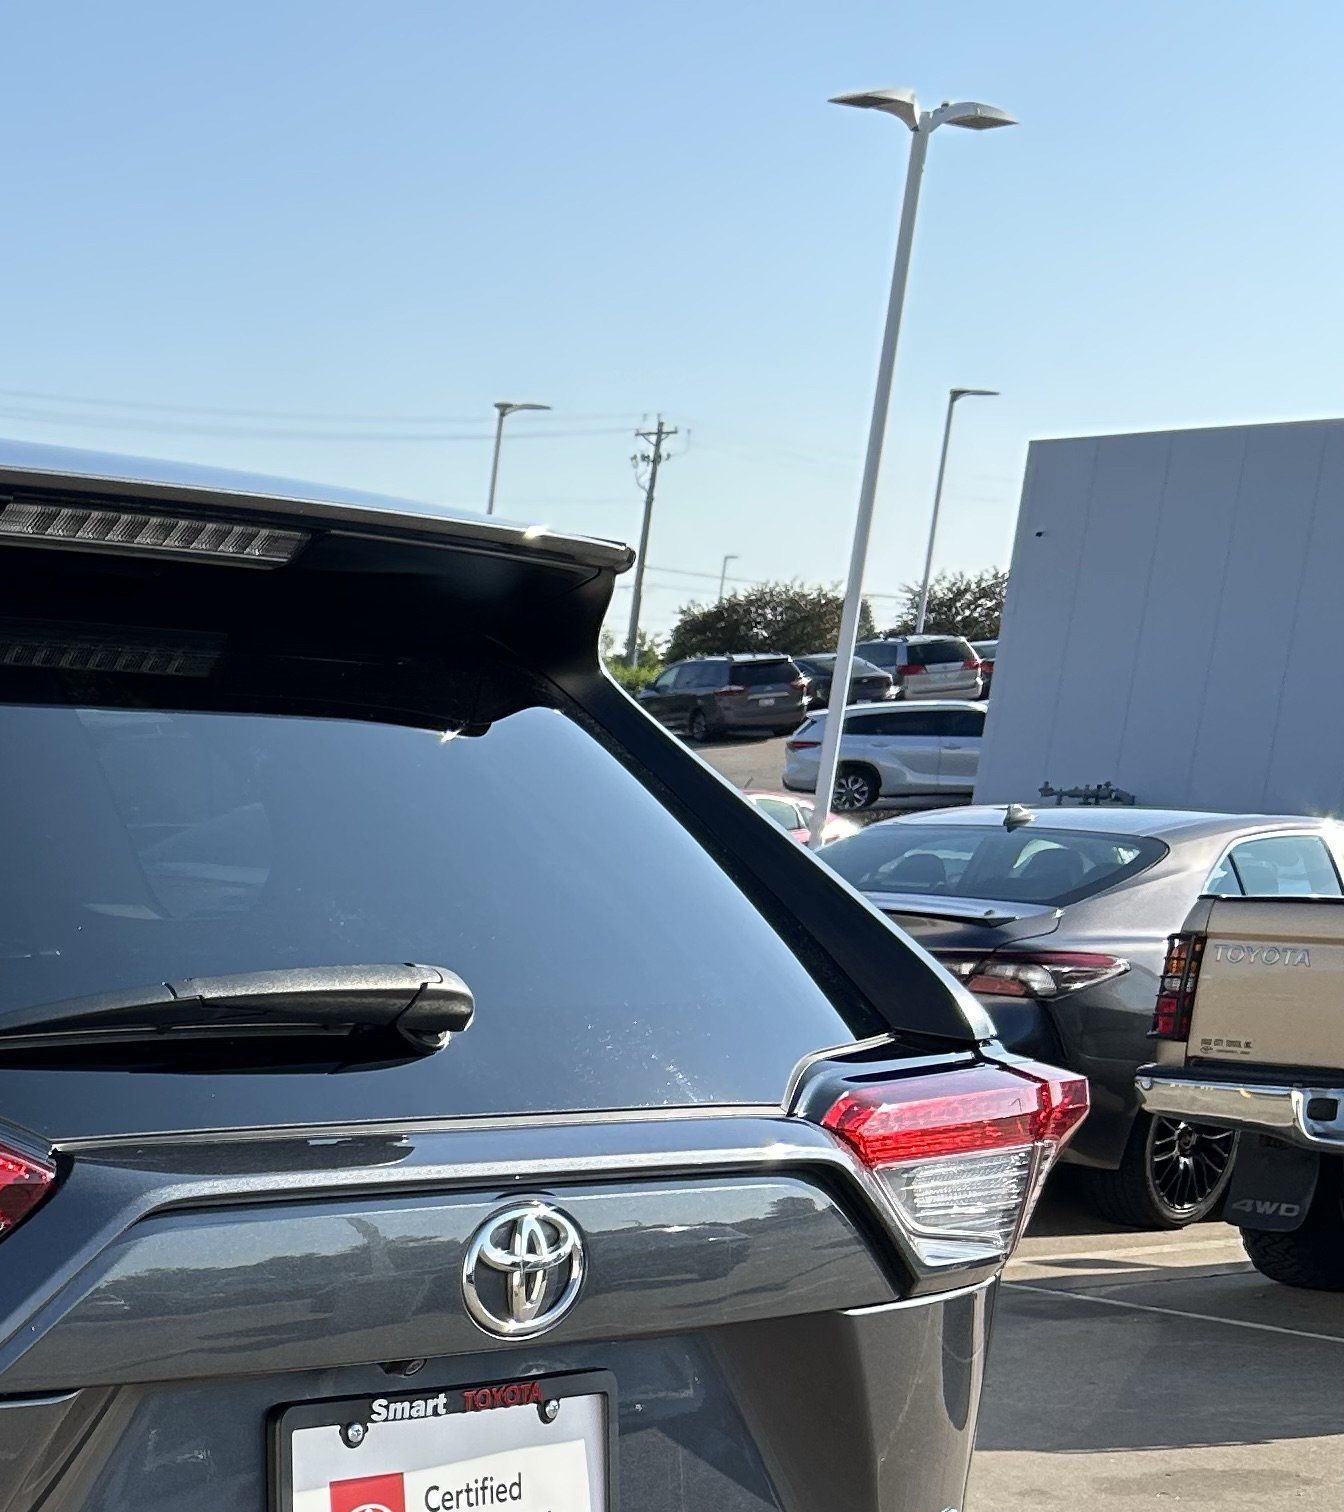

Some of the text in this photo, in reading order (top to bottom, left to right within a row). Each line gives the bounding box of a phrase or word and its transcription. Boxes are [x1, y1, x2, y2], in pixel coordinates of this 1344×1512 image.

[1215, 944, 1311, 967] TOYOTA
[1231, 1199, 1301, 1217] 4WD
[370, 1382, 544, 1422] Smart TOYOTA
